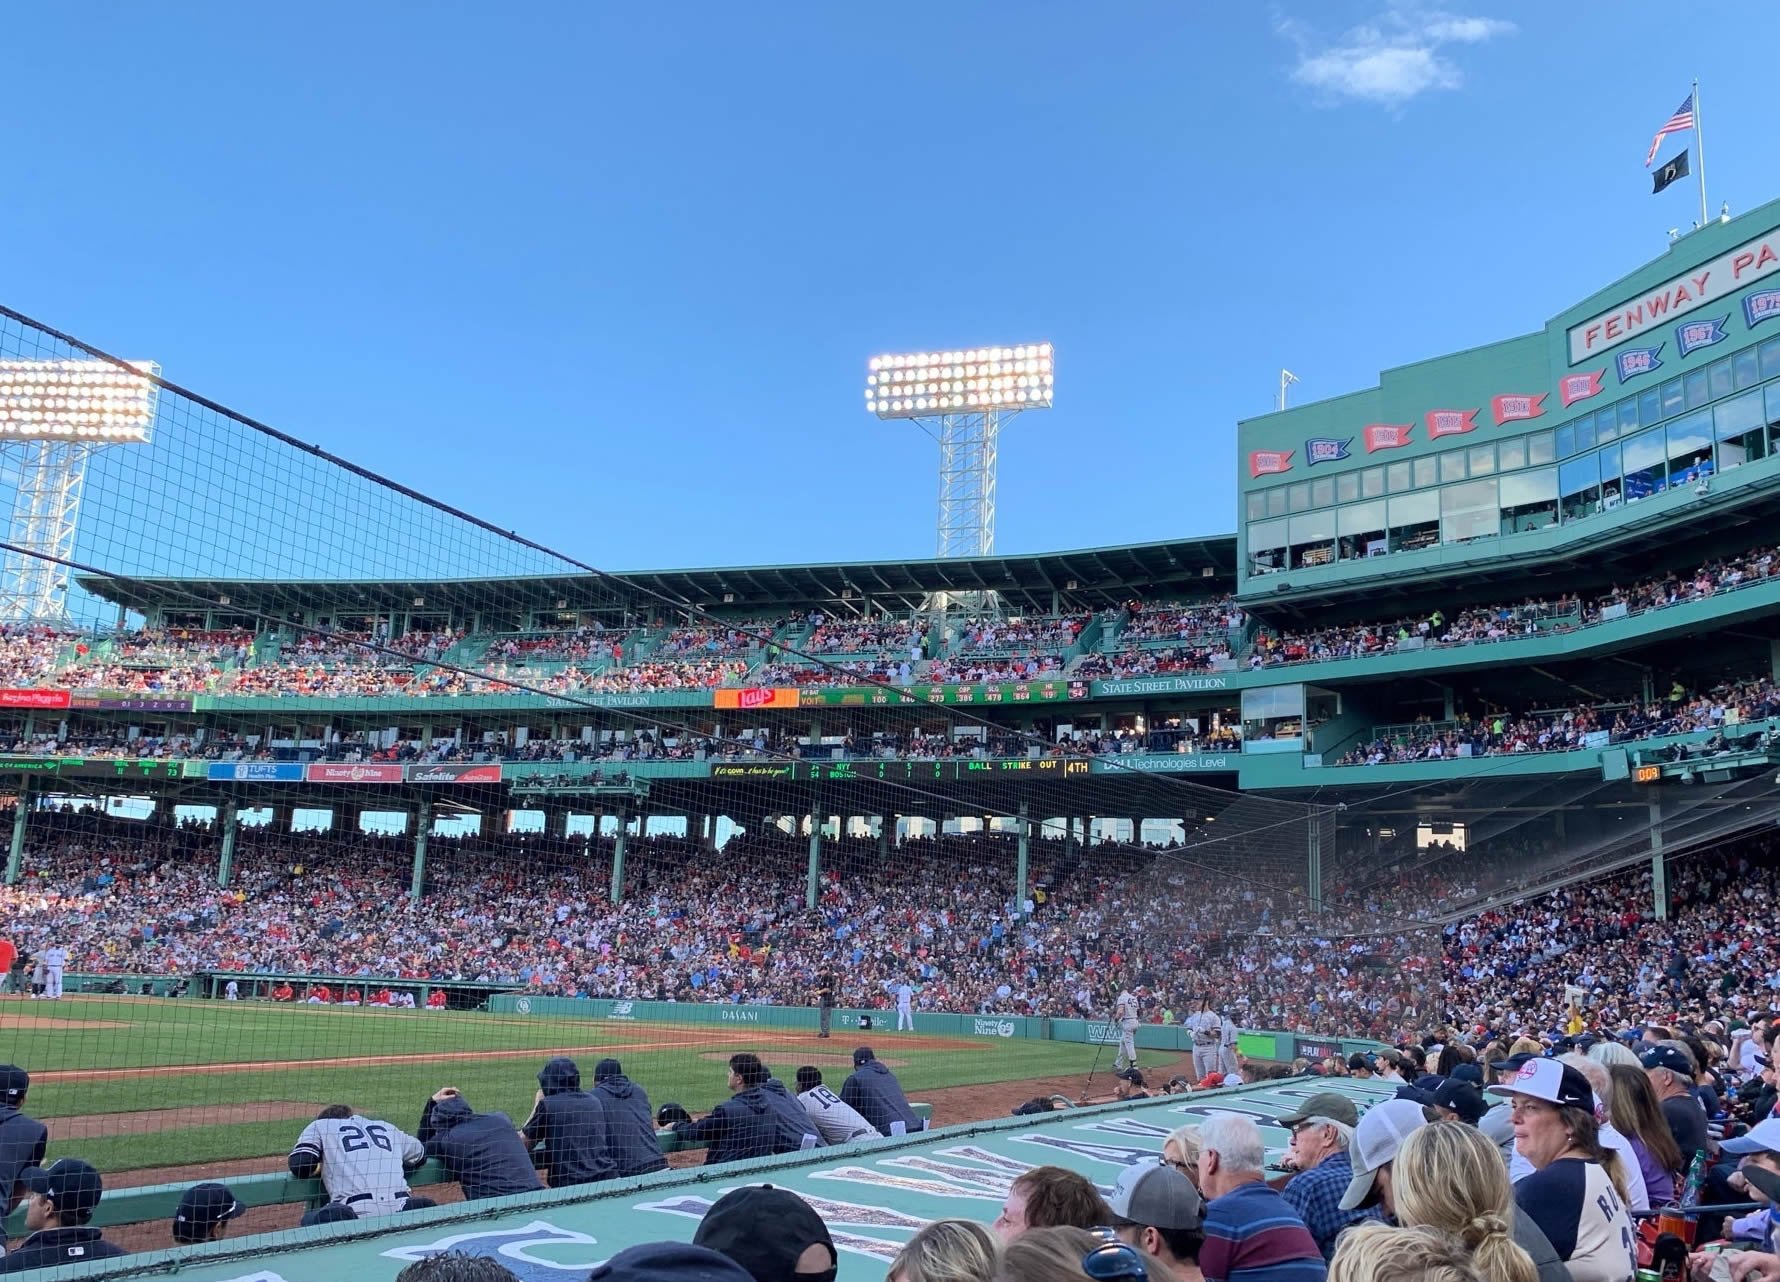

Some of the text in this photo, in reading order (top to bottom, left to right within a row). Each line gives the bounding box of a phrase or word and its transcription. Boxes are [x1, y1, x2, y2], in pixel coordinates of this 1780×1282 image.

[1584, 244, 1779, 349] FENWAY PA
[1102, 678, 1226, 694] STATE STREET PAVILION
[607, 696, 650, 706] PAVILION
[1002, 762, 1032, 770] STRIKE
[1039, 760, 1057, 768] OUT
[1068, 762, 1088, 772] 4TH
[1134, 758, 1197, 771] Technologies
[1200, 756, 1226, 768] Level
[249, 765, 277, 773] TUFTS
[722, 1010, 758, 1023] DASANI
[974, 1018, 998, 1028] Ninety
[974, 1026, 998, 1035] Nine
[810, 1088, 840, 1110] 18
[340, 1125, 392, 1152] 26
